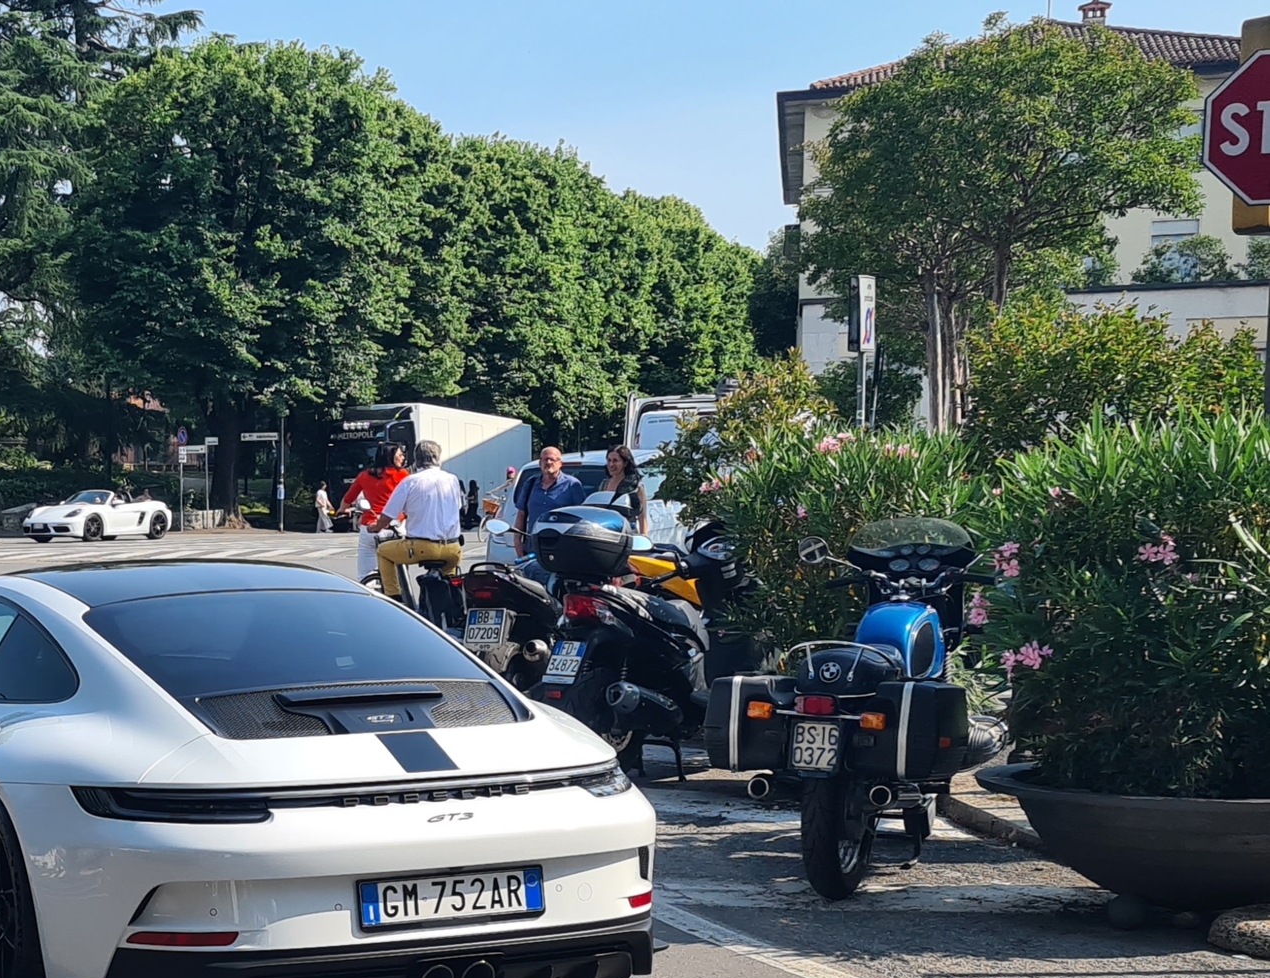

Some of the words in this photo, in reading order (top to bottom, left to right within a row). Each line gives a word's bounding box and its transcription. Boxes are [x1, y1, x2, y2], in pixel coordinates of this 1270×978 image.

[478, 612, 491, 624] BB
[468, 627, 500, 640] 07209
[562, 643, 573, 655] FD
[548, 658, 579, 673] 34872
[793, 747, 837, 766] 0372
[343, 785, 529, 807] PORSCHE
[426, 812, 474, 823] GT3
[382, 882, 420, 918] GM
[431, 874, 523, 915] 752AR
